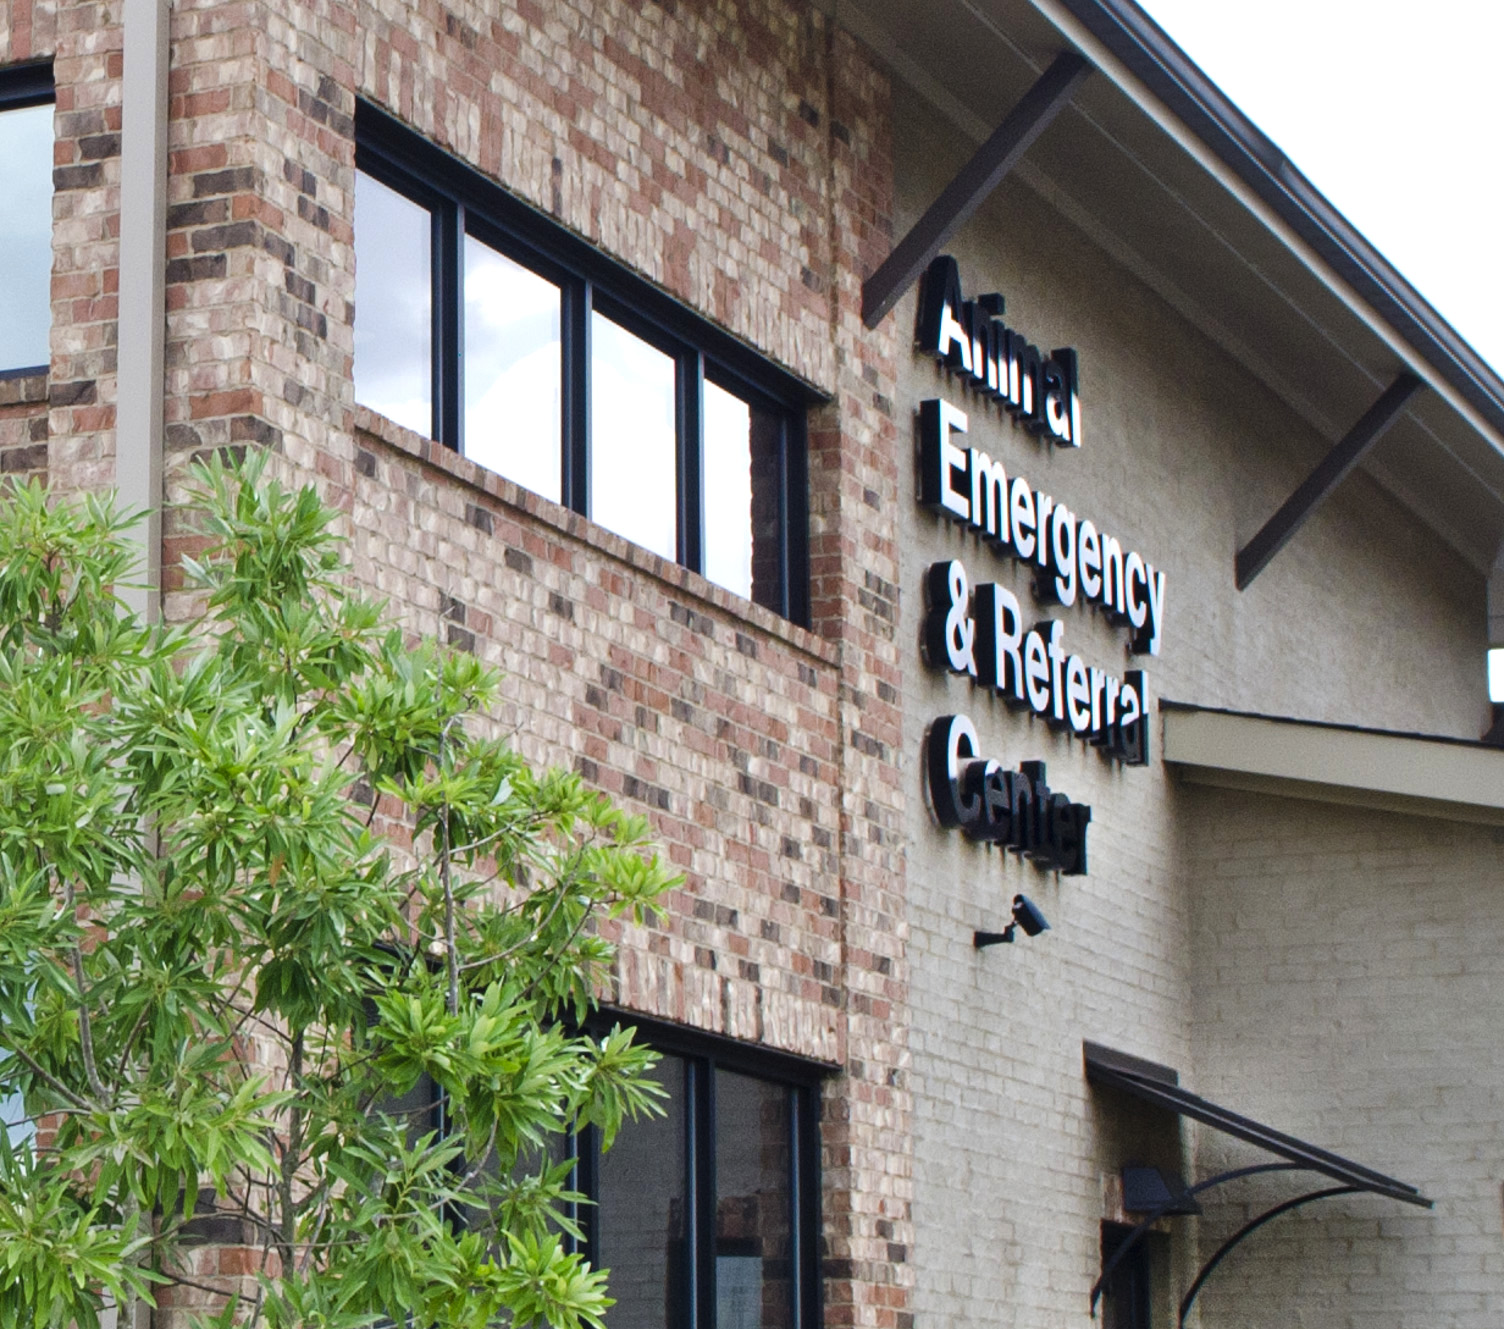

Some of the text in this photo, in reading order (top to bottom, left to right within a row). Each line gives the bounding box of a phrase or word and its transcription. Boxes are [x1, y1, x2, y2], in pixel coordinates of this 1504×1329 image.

[922, 255, 1082, 448] Animal
[921, 399, 1165, 656] Emergency
[929, 559, 1150, 766] & Referral
[929, 714, 1091, 876] Center
